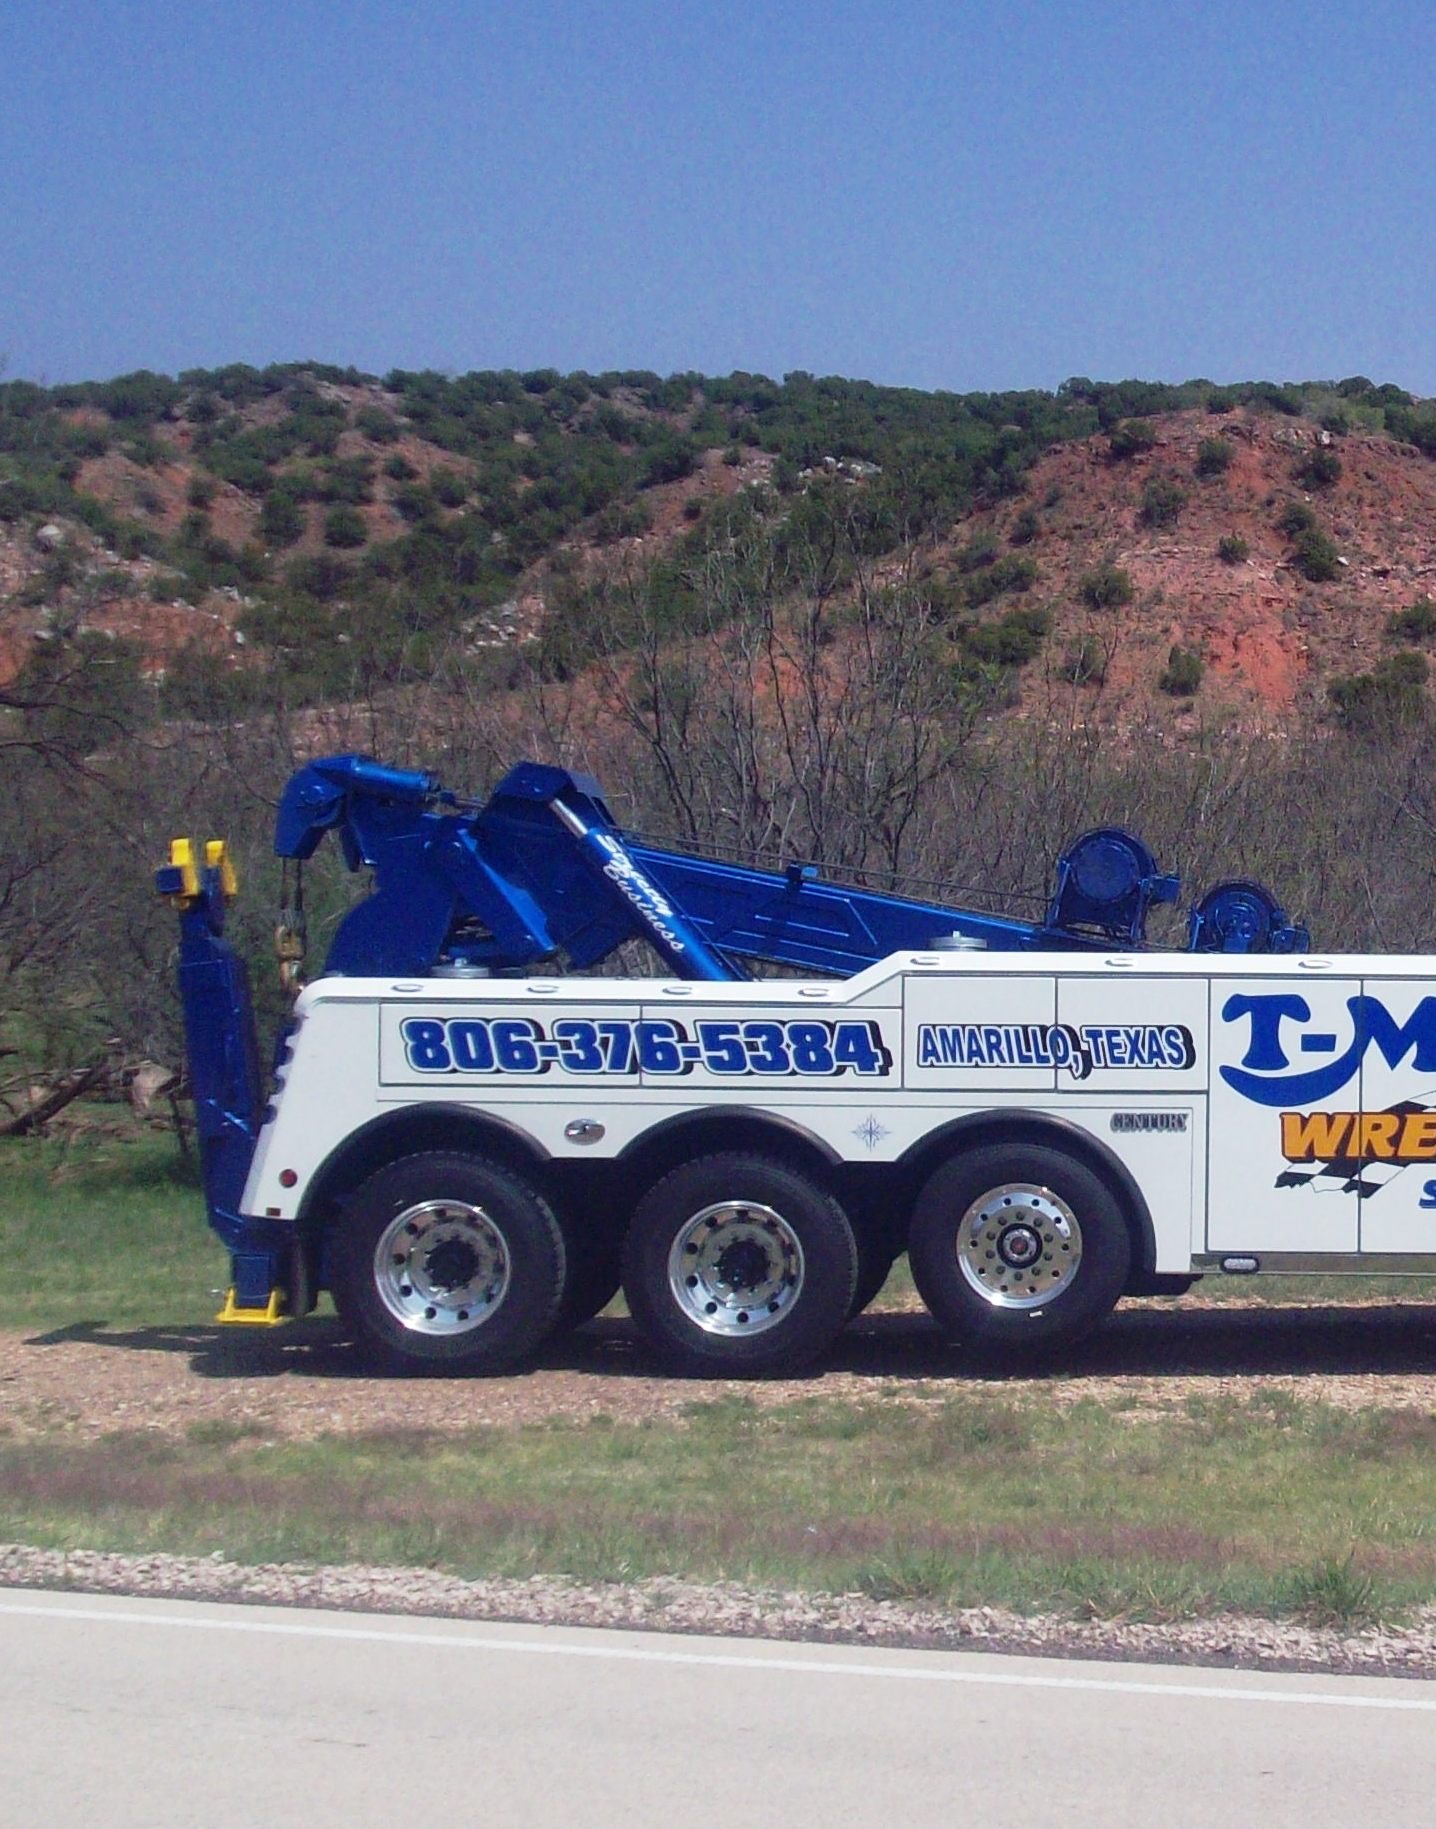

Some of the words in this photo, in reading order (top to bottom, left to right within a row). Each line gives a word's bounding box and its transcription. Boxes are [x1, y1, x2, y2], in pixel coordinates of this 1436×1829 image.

[603, 860, 686, 952] Business
[400, 1017, 893, 1077] 806-376-5384
[917, 1024, 1093, 1080] AMARILLO,
[1080, 1025, 1196, 1069] TEXAS
[1110, 1112, 1189, 1134] CENTURY
